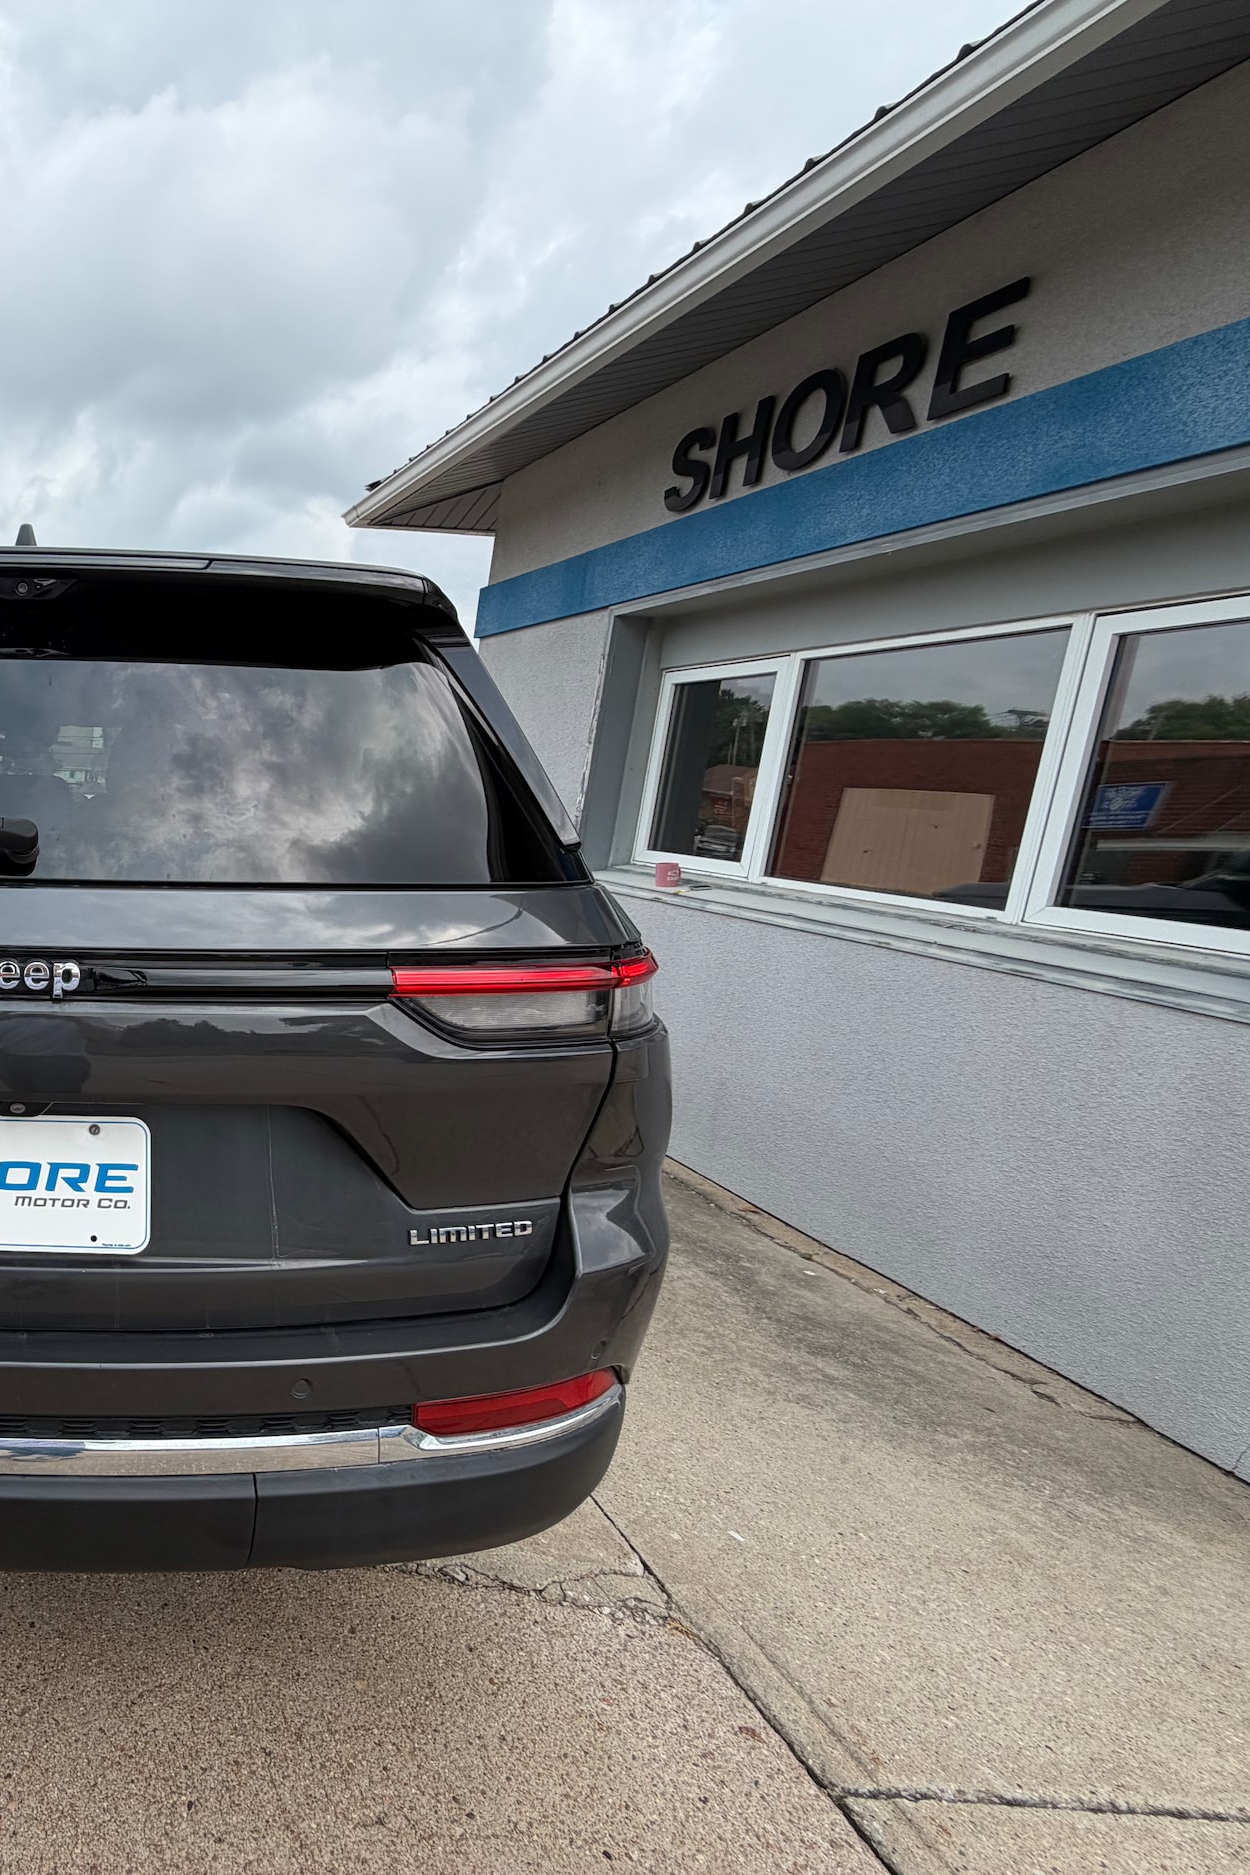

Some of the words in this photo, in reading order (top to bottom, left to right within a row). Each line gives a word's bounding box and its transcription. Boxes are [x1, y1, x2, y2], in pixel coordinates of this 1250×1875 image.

[664, 277, 1031, 512] SHORE
[14, 1195, 90, 1209] MOTOR
[410, 1220, 533, 1245] LIMITED
